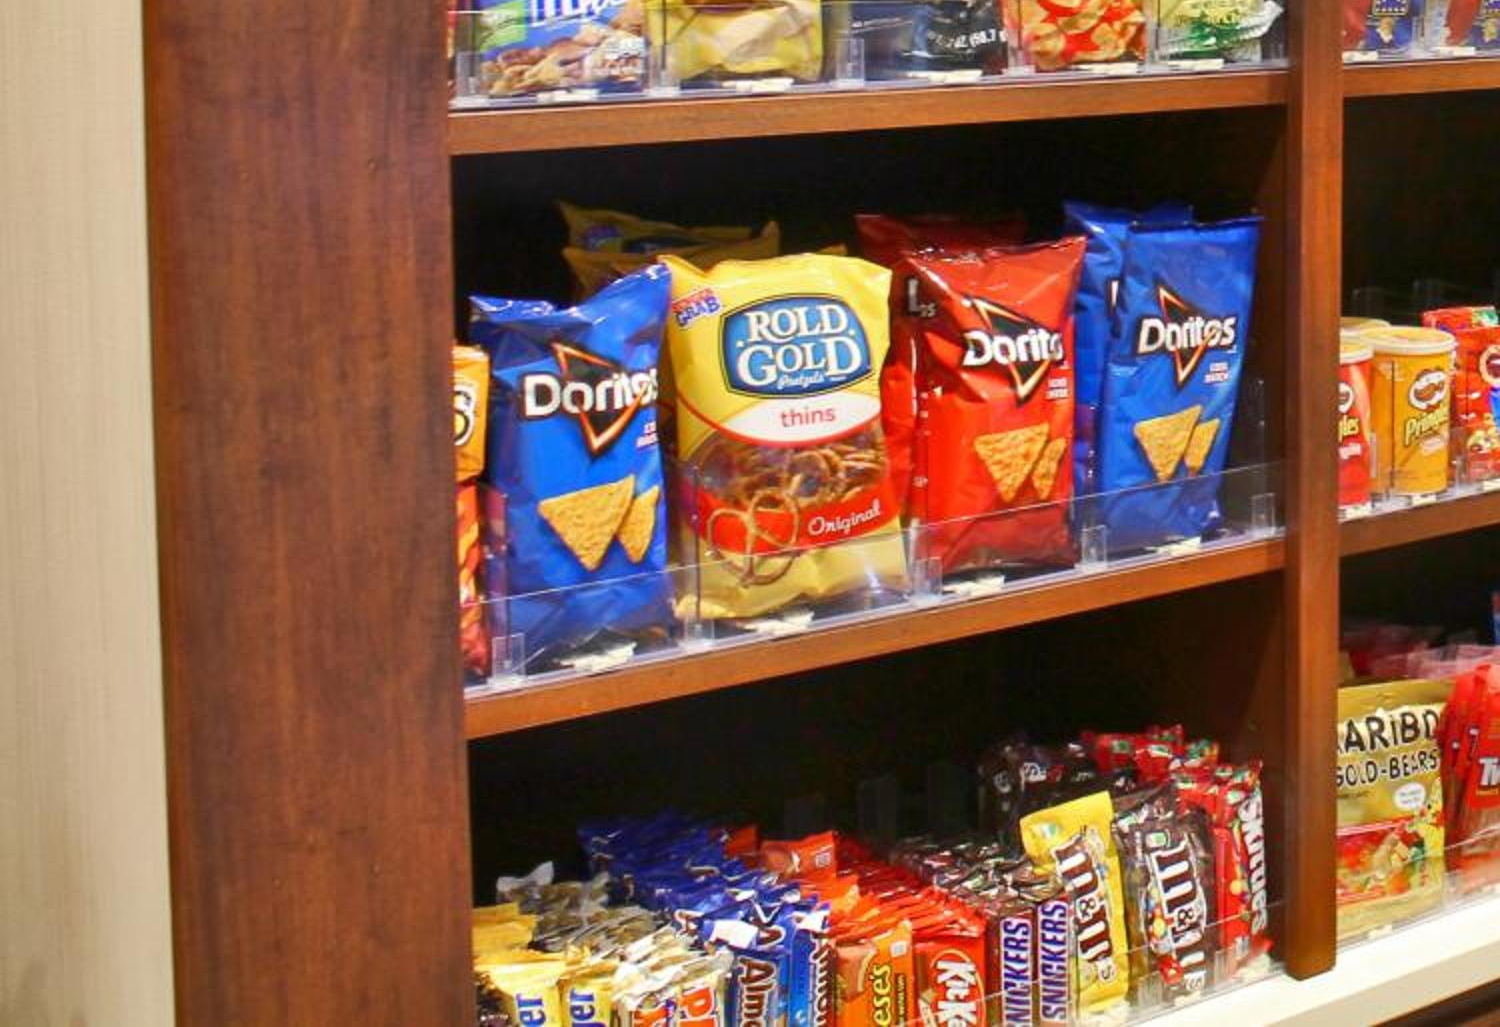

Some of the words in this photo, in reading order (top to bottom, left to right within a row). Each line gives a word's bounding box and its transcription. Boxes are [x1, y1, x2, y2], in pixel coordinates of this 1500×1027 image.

[676, 295, 721, 327] GRAB
[744, 304, 849, 343] ROLD
[962, 327, 1064, 367] Dorito
[1138, 316, 1237, 354] Doritos
[736, 336, 863, 387] GOLD
[779, 406, 837, 428] thins
[807, 500, 882, 539] Original
[1338, 709, 1439, 753] ARIBO
[1001, 918, 1032, 1027] NICKERS
[1039, 900, 1069, 1022] SNICKERS
